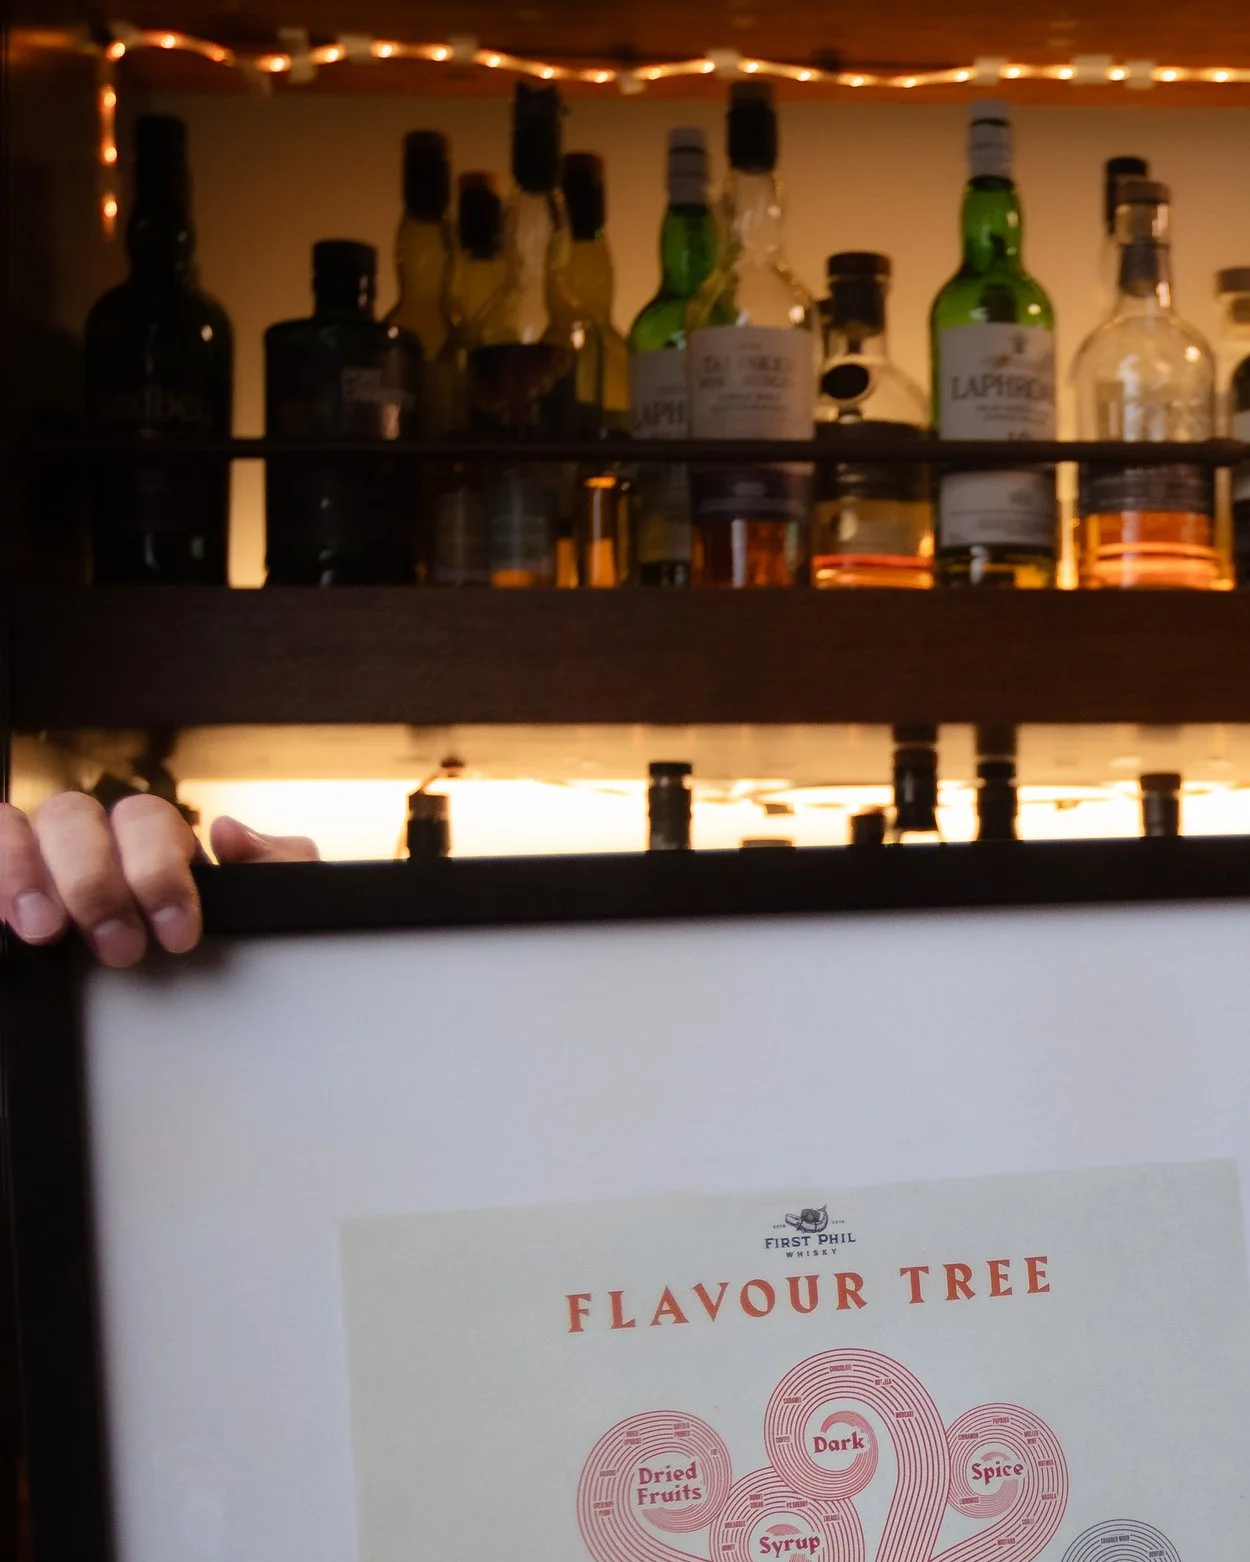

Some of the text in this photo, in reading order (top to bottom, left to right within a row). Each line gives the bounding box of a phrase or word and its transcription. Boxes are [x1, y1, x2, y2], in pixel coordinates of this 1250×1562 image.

[764, 1232, 856, 1249] FIRST PHIL
[786, 1248, 836, 1258] WHISKY
[565, 1256, 1050, 1333] FLAVOUR TREE
[813, 1431, 865, 1454] Dark
[638, 1461, 698, 1485] Dried
[971, 1461, 1024, 1485] Spice
[636, 1485, 702, 1505] Fruits
[759, 1535, 820, 1558] Syrup
